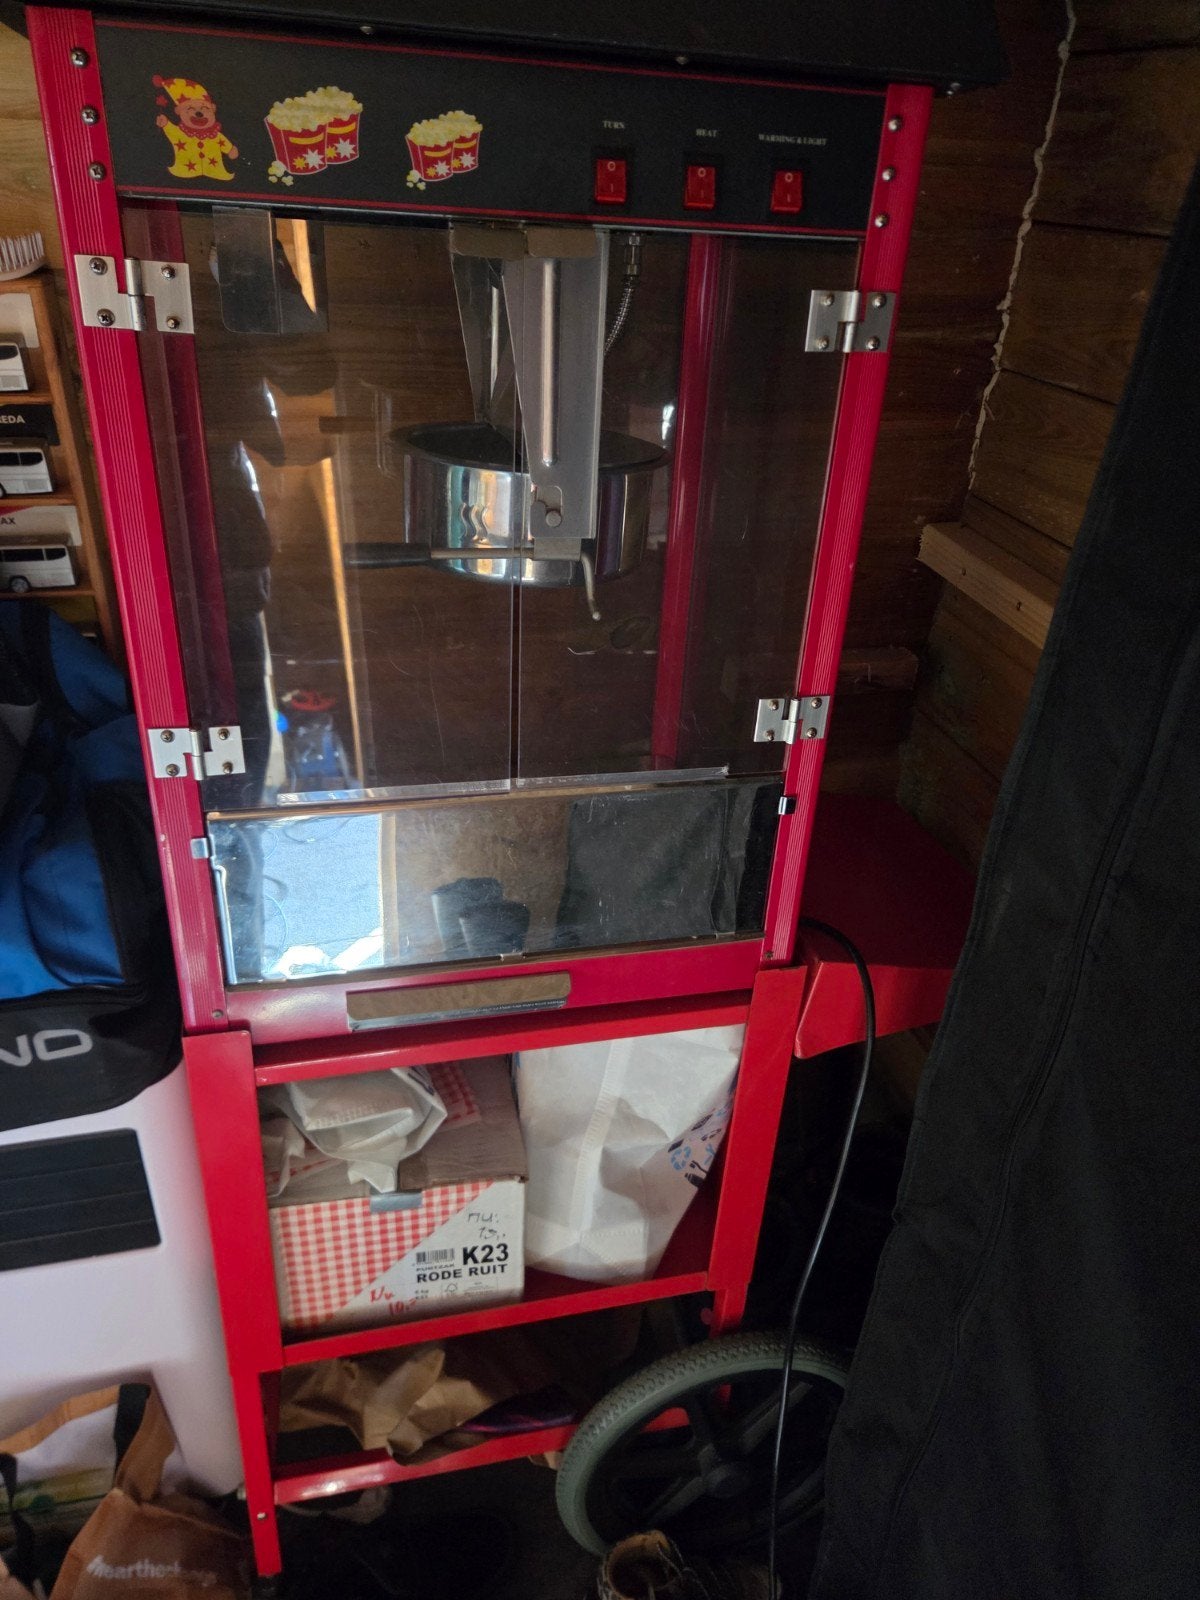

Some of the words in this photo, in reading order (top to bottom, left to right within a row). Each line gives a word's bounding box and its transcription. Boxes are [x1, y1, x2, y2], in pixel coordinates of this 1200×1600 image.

[602, 119, 626, 130] TURN
[695, 128, 719, 138] HEAT
[462, 1242, 509, 1266] K23
[416, 1268, 463, 1284] RODE
[468, 1263, 508, 1277] RUIT
